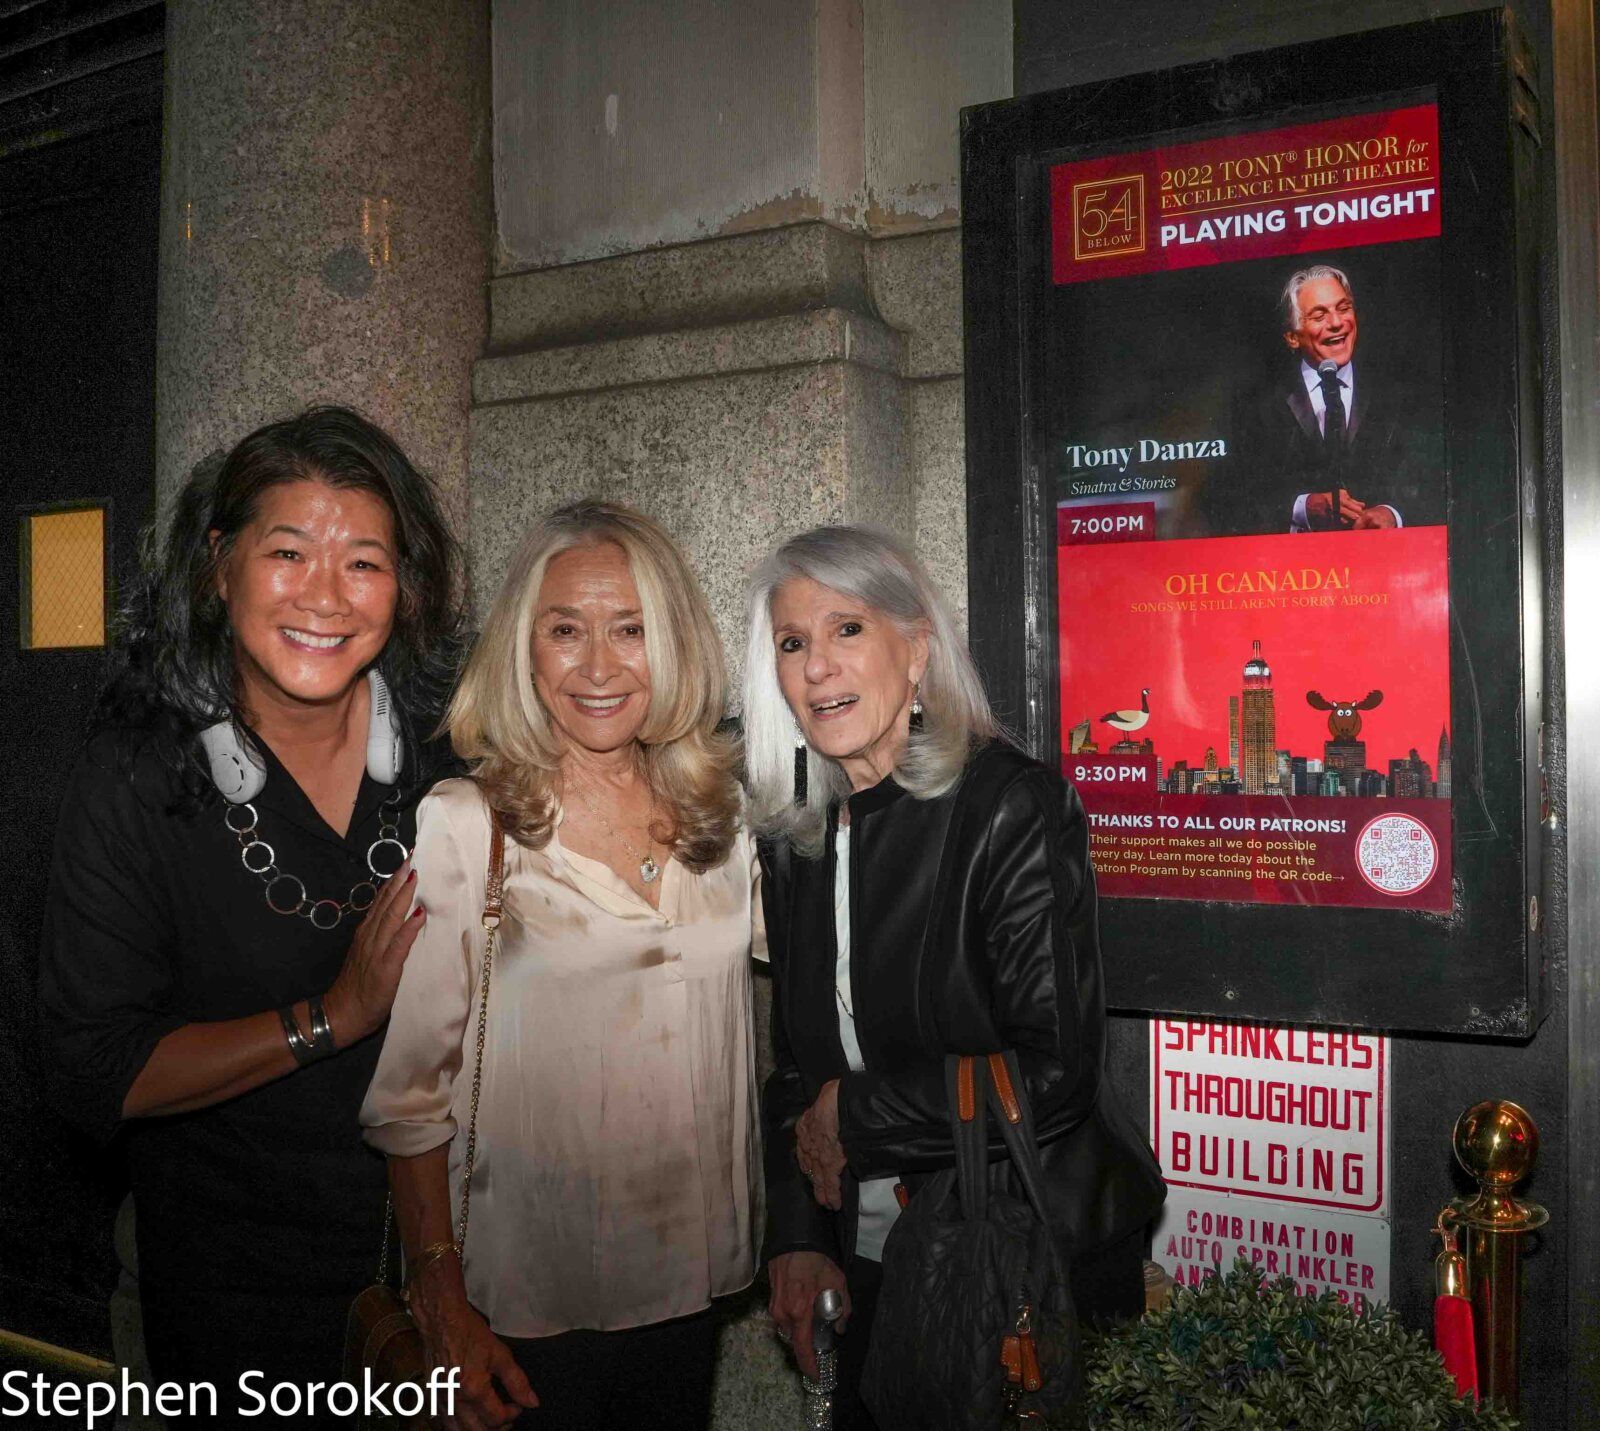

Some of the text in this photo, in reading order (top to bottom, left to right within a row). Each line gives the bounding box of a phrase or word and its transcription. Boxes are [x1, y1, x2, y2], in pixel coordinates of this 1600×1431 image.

[1161, 166, 1213, 191] 2022
[1304, 136, 1399, 169] HONOR
[1405, 139, 1429, 157] for
[1161, 157, 1429, 209] EXCELLENCE IN THE THEATRE
[1081, 188, 1137, 237] 54
[1161, 188, 1436, 247] PLAYING TONIGHT
[1087, 234, 1132, 249] BELOW
[1066, 438, 1227, 472] Tony Danza
[1070, 475, 1176, 496] Sinatra & Stories
[1165, 567, 1351, 596] OH CANADA!
[1130, 602, 1174, 613] SONGS
[1176, 601, 1196, 612] WE
[1199, 600, 1236, 611] STILL
[1291, 596, 1336, 608] SORRY
[1089, 813, 1346, 833] THANKS TO ALL OUR PATRONS!
[1089, 849, 1315, 866] every day. Learn more today about the
[1090, 833, 1317, 853] Their support makes all we do possible
[1130, 864, 1178, 878] Program
[1182, 866, 1197, 880] by
[1199, 868, 1252, 882] scanning
[1256, 869, 1276, 880] the
[1279, 870, 1298, 882] QR
[1165, 1018, 1373, 1069] SPRINKLERS
[1165, 1070, 1373, 1132] THROUGHOUT
[1172, 1131, 1364, 1195] BUILDING
[1186, 1209, 1353, 1257] COMBINATION
[1166, 1235, 1223, 1264] AUTO
